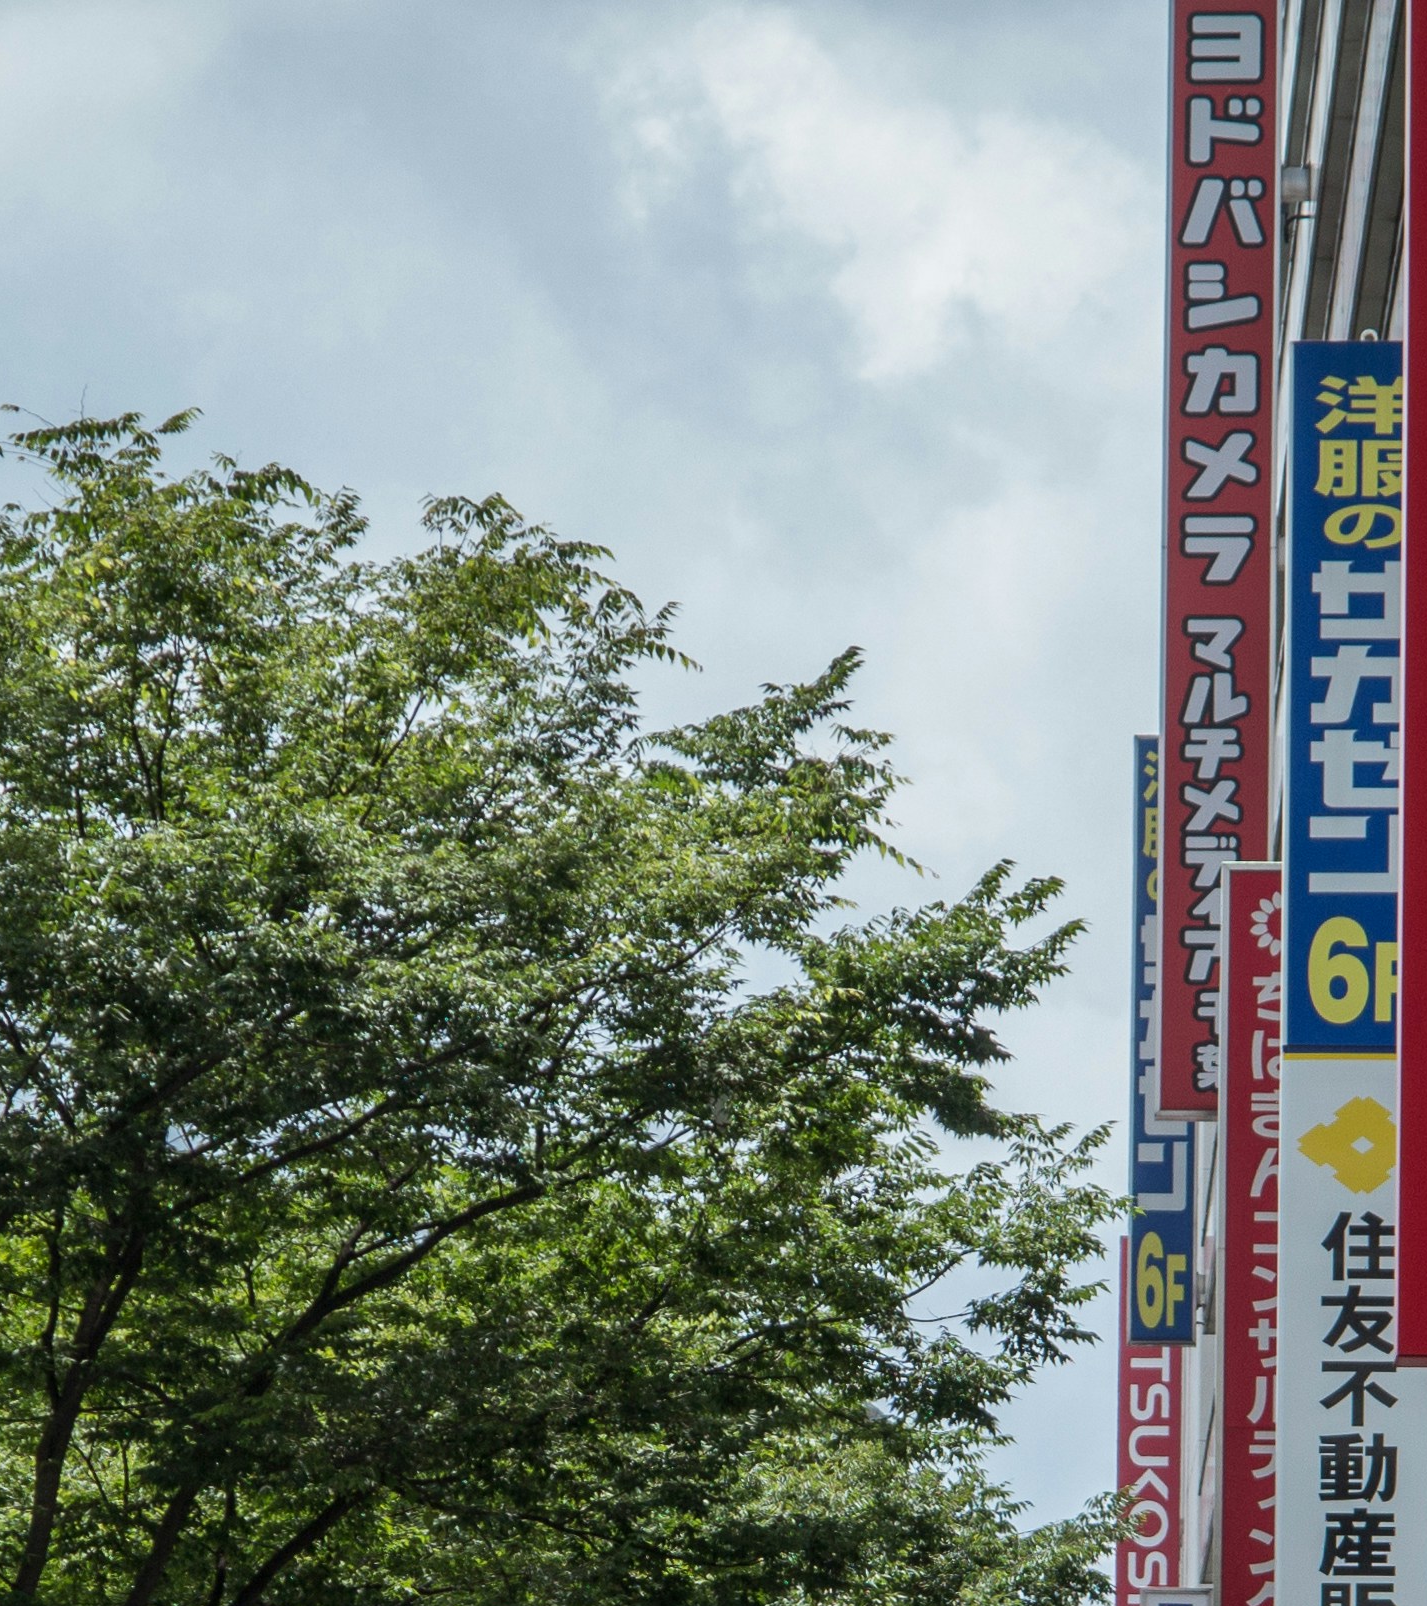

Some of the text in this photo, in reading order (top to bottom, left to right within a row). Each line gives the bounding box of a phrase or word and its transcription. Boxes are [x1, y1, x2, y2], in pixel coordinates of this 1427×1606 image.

[1179, 12, 1265, 585] ヨドバシカメラ
[1135, 1231, 1186, 1329] 6F
